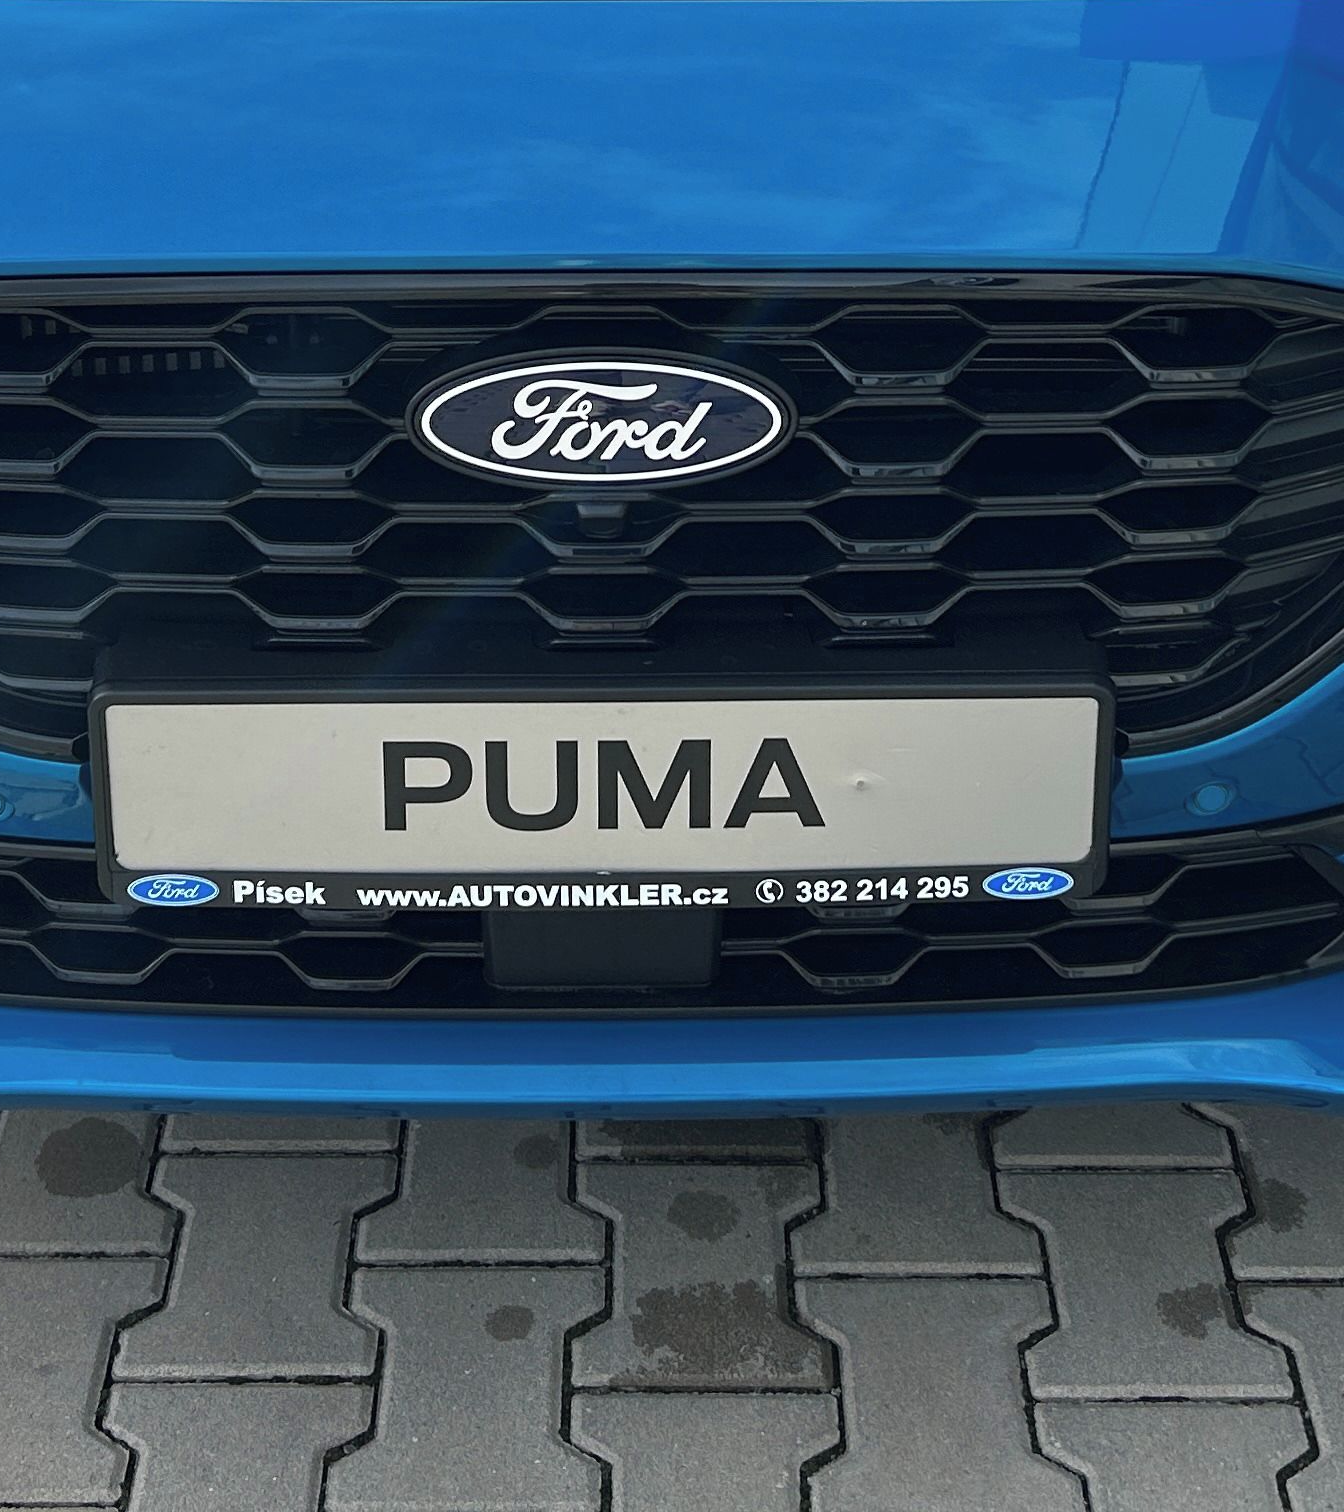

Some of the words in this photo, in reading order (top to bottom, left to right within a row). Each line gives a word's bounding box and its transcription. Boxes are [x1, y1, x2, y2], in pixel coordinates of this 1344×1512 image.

[490, 378, 714, 461] Ford
[382, 737, 826, 832] PUMA
[147, 879, 201, 900] Ford
[232, 879, 327, 905] Písek
[355, 884, 730, 908] www.AUTOVINKLER.cz
[795, 879, 848, 903] 382
[856, 877, 909, 901] 214
[916, 875, 970, 899] 295
[1001, 872, 1054, 893] Ford
